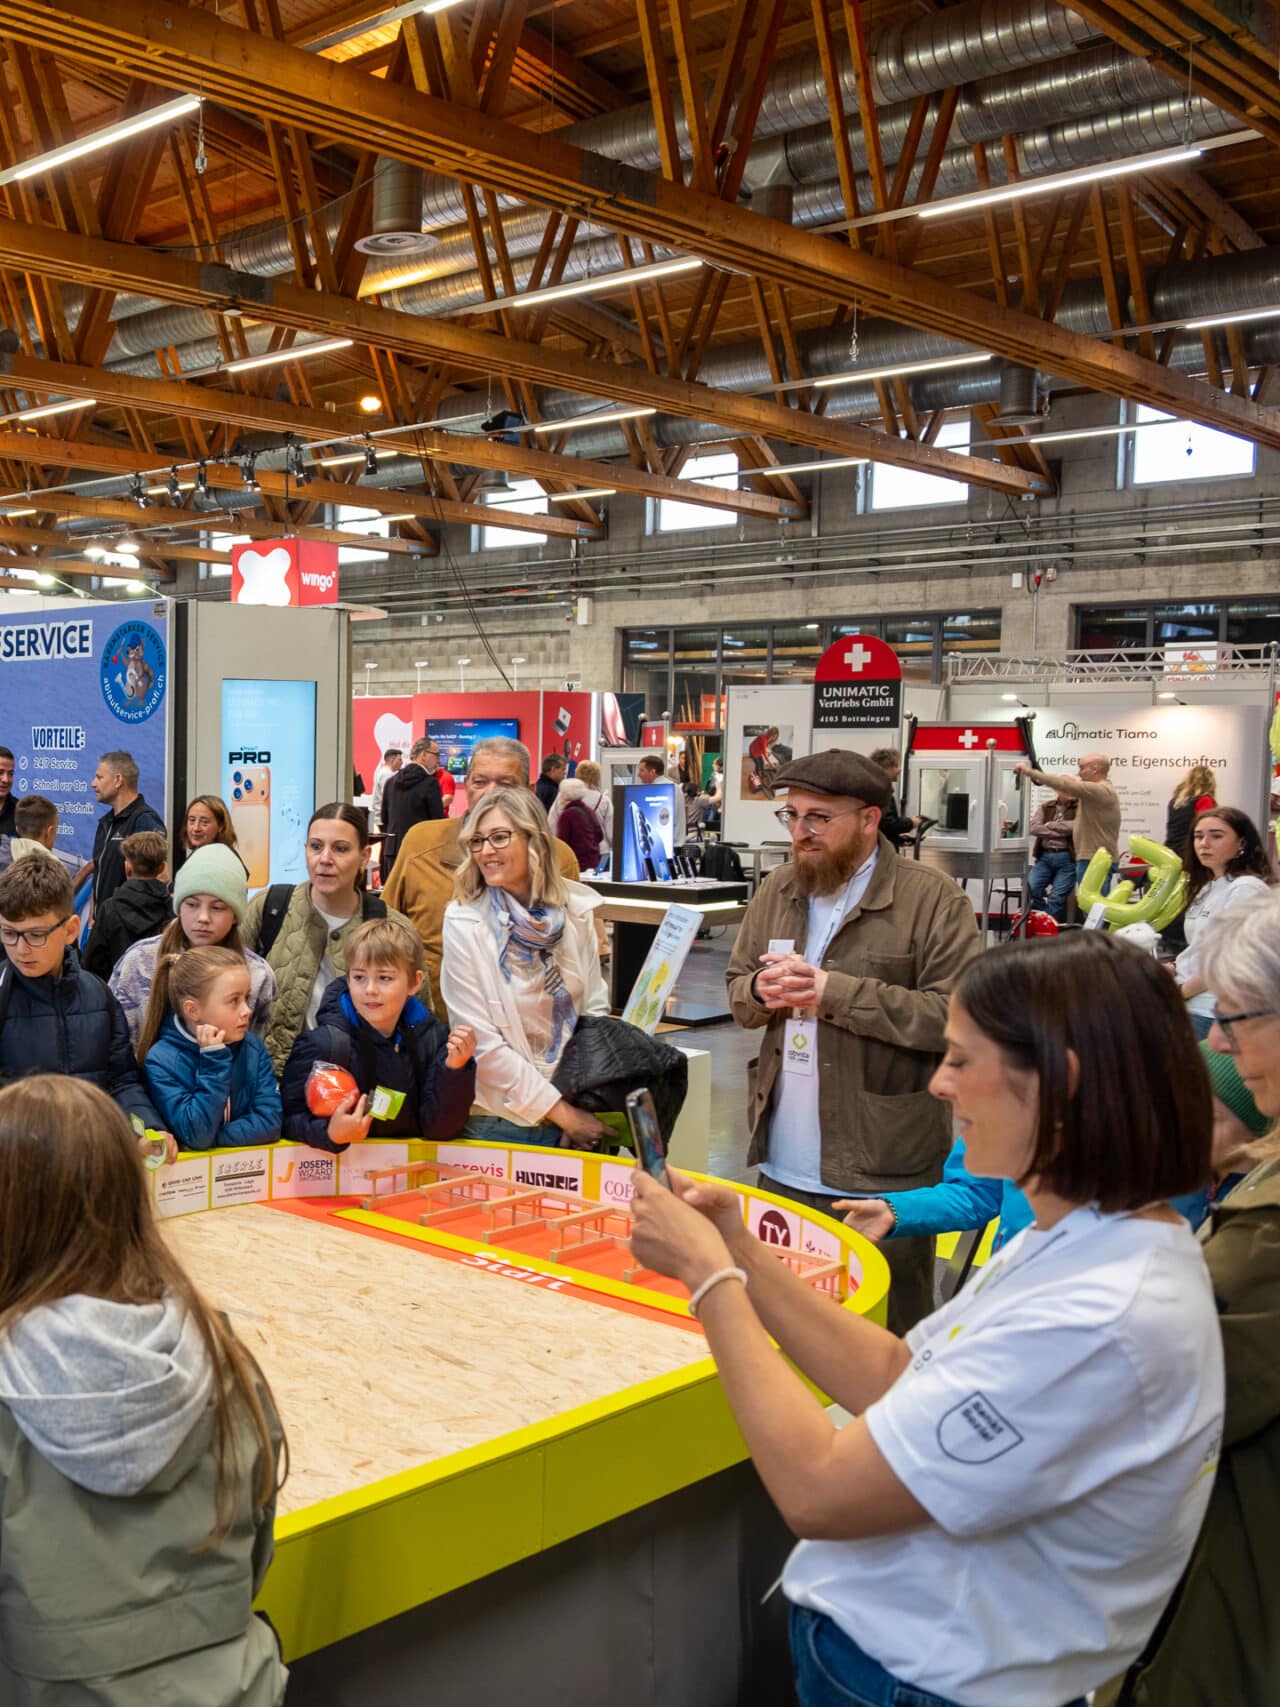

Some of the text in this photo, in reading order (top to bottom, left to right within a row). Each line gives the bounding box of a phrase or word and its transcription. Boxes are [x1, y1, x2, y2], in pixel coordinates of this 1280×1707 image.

[301, 571, 334, 592] wingo
[103, 673, 165, 721] ablaufservice-profi.ch
[822, 685, 890, 697] UNIMATIC
[819, 697, 894, 708] Vertriebs GmbH
[32, 726, 86, 750] VORTEILE:
[1116, 729, 1158, 740] Tiamo
[229, 751, 271, 765] PRO
[1132, 756, 1227, 770] Eigenschaften
[64, 801, 94, 815] Technik
[299, 1160, 333, 1170] JOSEPH
[298, 1168, 333, 1177] WIZARD
[461, 1251, 573, 1290] Start
